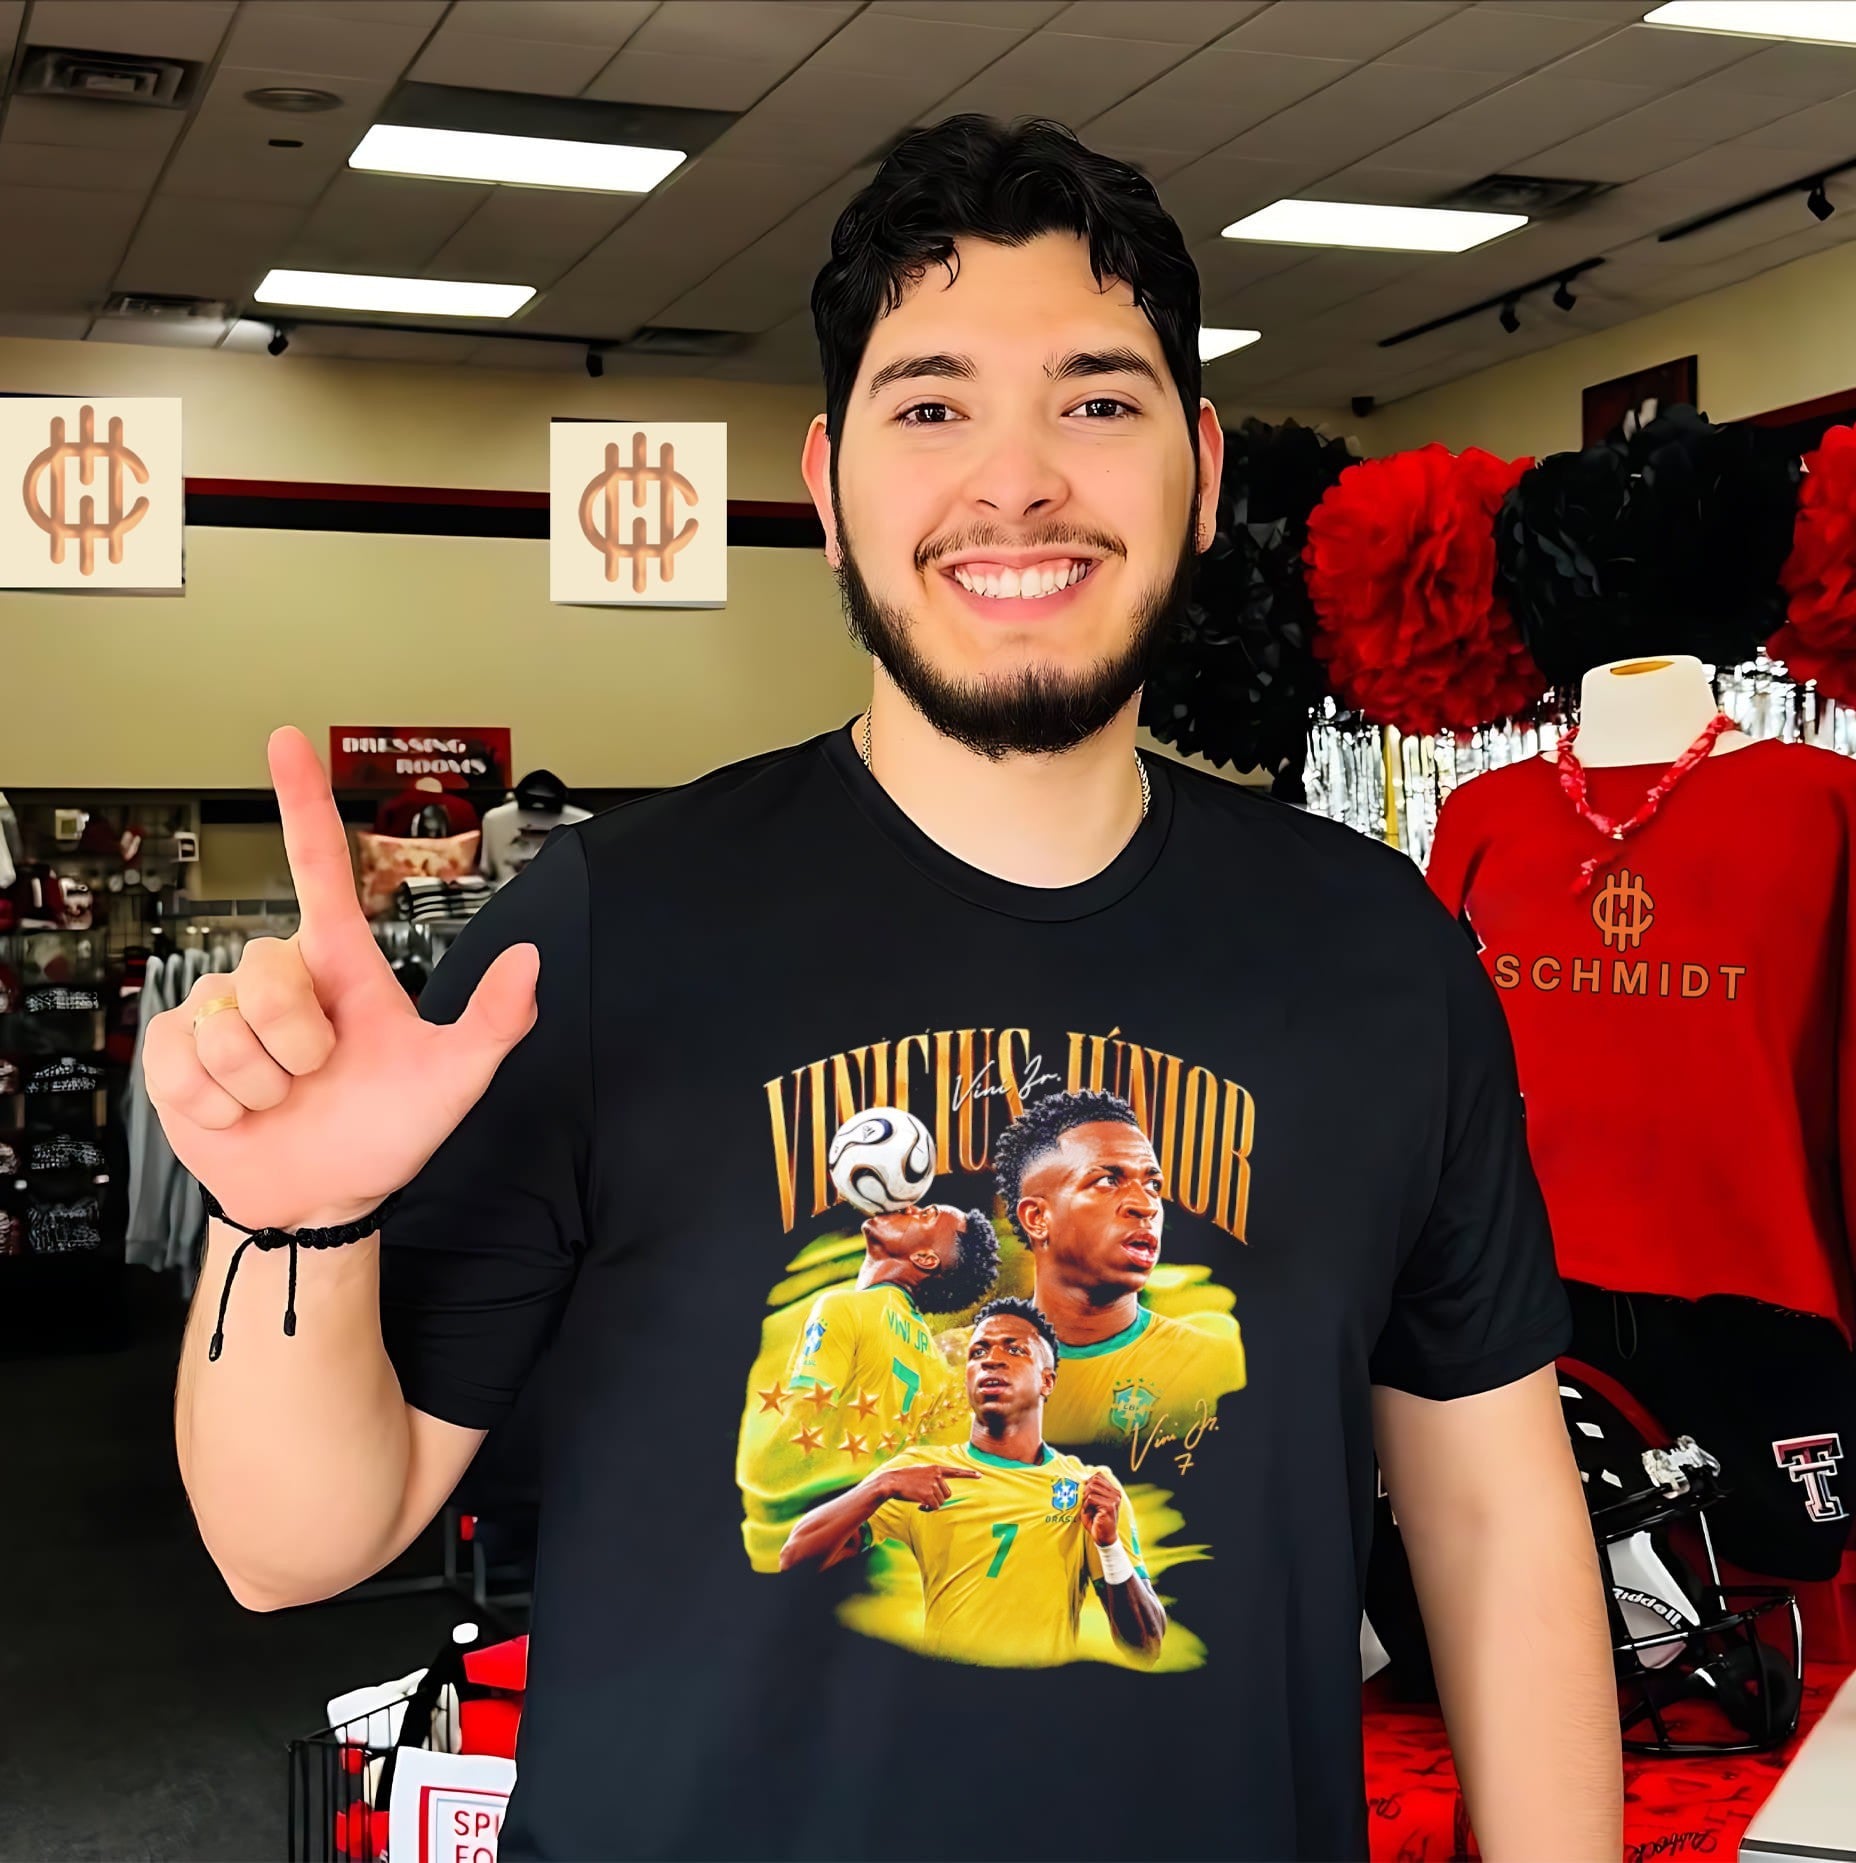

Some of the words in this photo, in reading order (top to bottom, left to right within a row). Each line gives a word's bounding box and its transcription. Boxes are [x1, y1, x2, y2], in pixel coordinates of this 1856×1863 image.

[342, 737, 467, 753] DRESSING
[396, 758, 487, 774] ROOMS
[1494, 953, 1747, 1000] SCHMIDT
[952, 1060, 1012, 1112] Vini
[886, 1308, 911, 1345] VINI
[914, 1329, 929, 1354] JR
[892, 1356, 921, 1415] 7
[1130, 1413, 1178, 1472] Vini
[1173, 1452, 1195, 1476] 7
[986, 1523, 1019, 1579] 7
